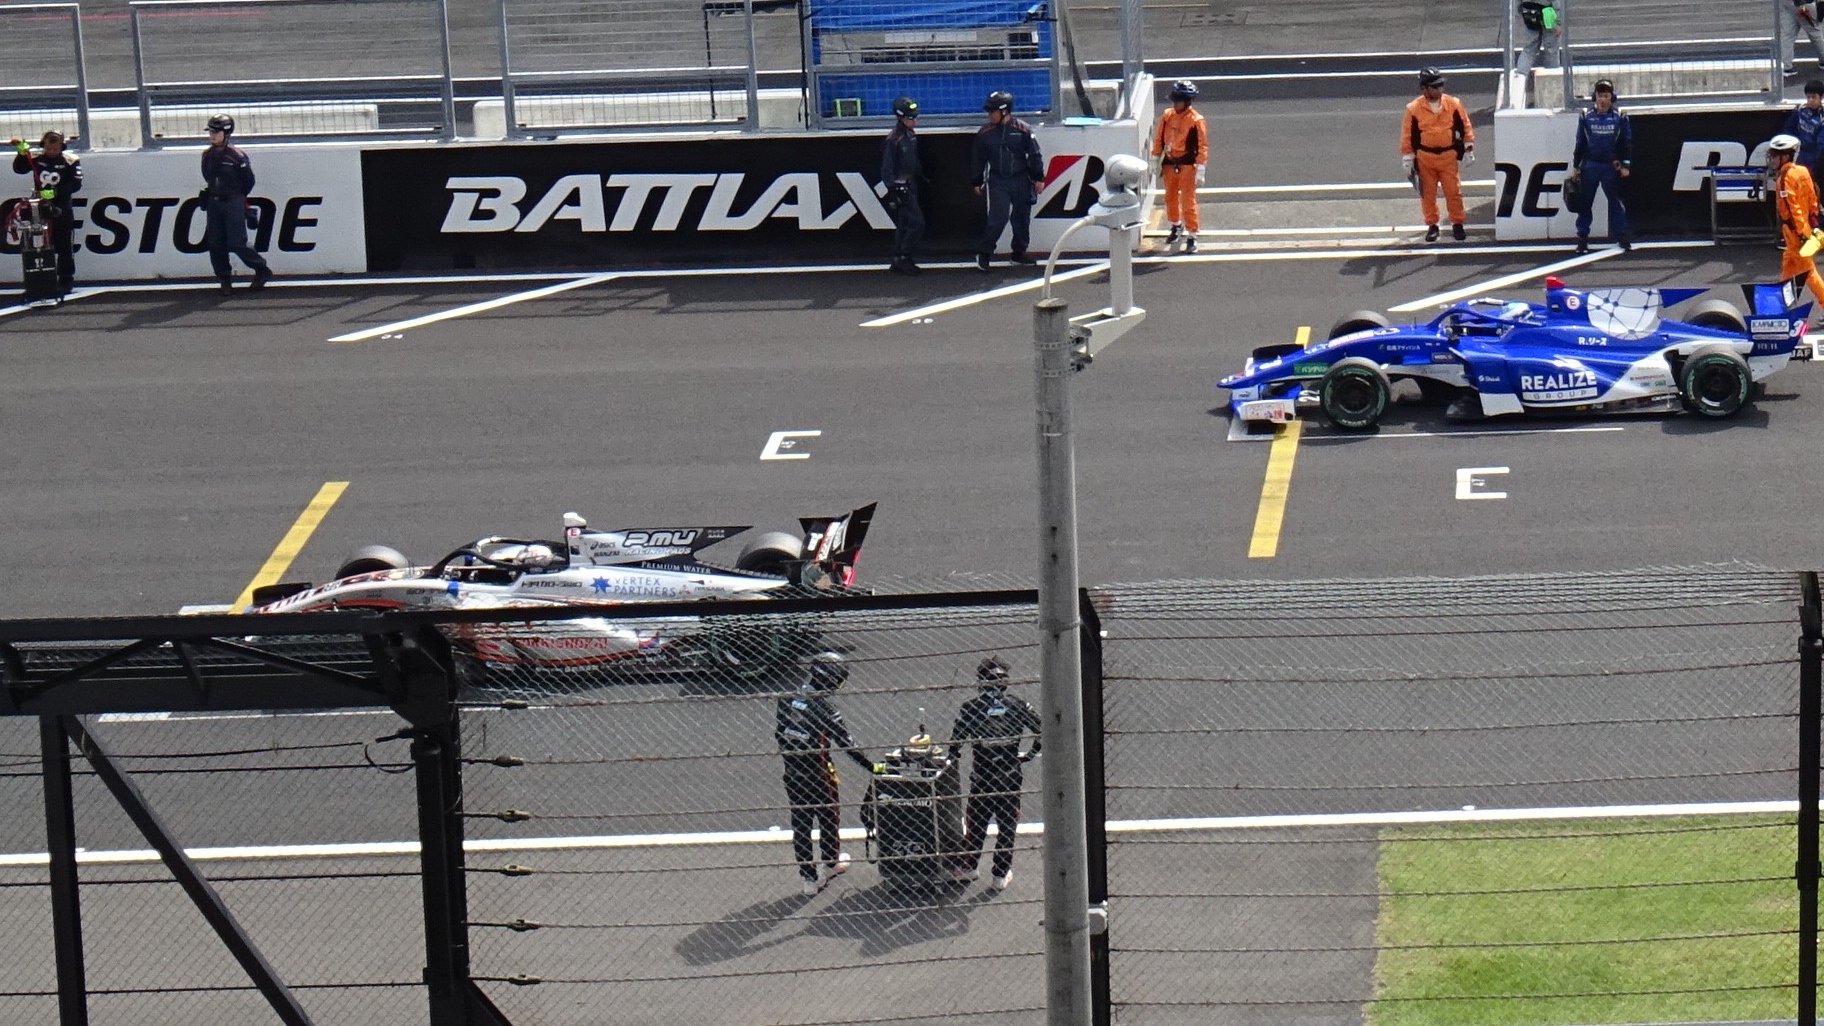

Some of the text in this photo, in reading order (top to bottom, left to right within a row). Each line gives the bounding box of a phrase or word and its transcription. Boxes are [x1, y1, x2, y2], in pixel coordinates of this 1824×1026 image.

[440, 173, 898, 233] BATTLAX
[1521, 370, 1597, 390] REALIZE
[641, 561, 711, 574] PREMIUM WATER
[614, 576, 661, 586] VERTEX
[613, 585, 677, 597] PARTNERS
